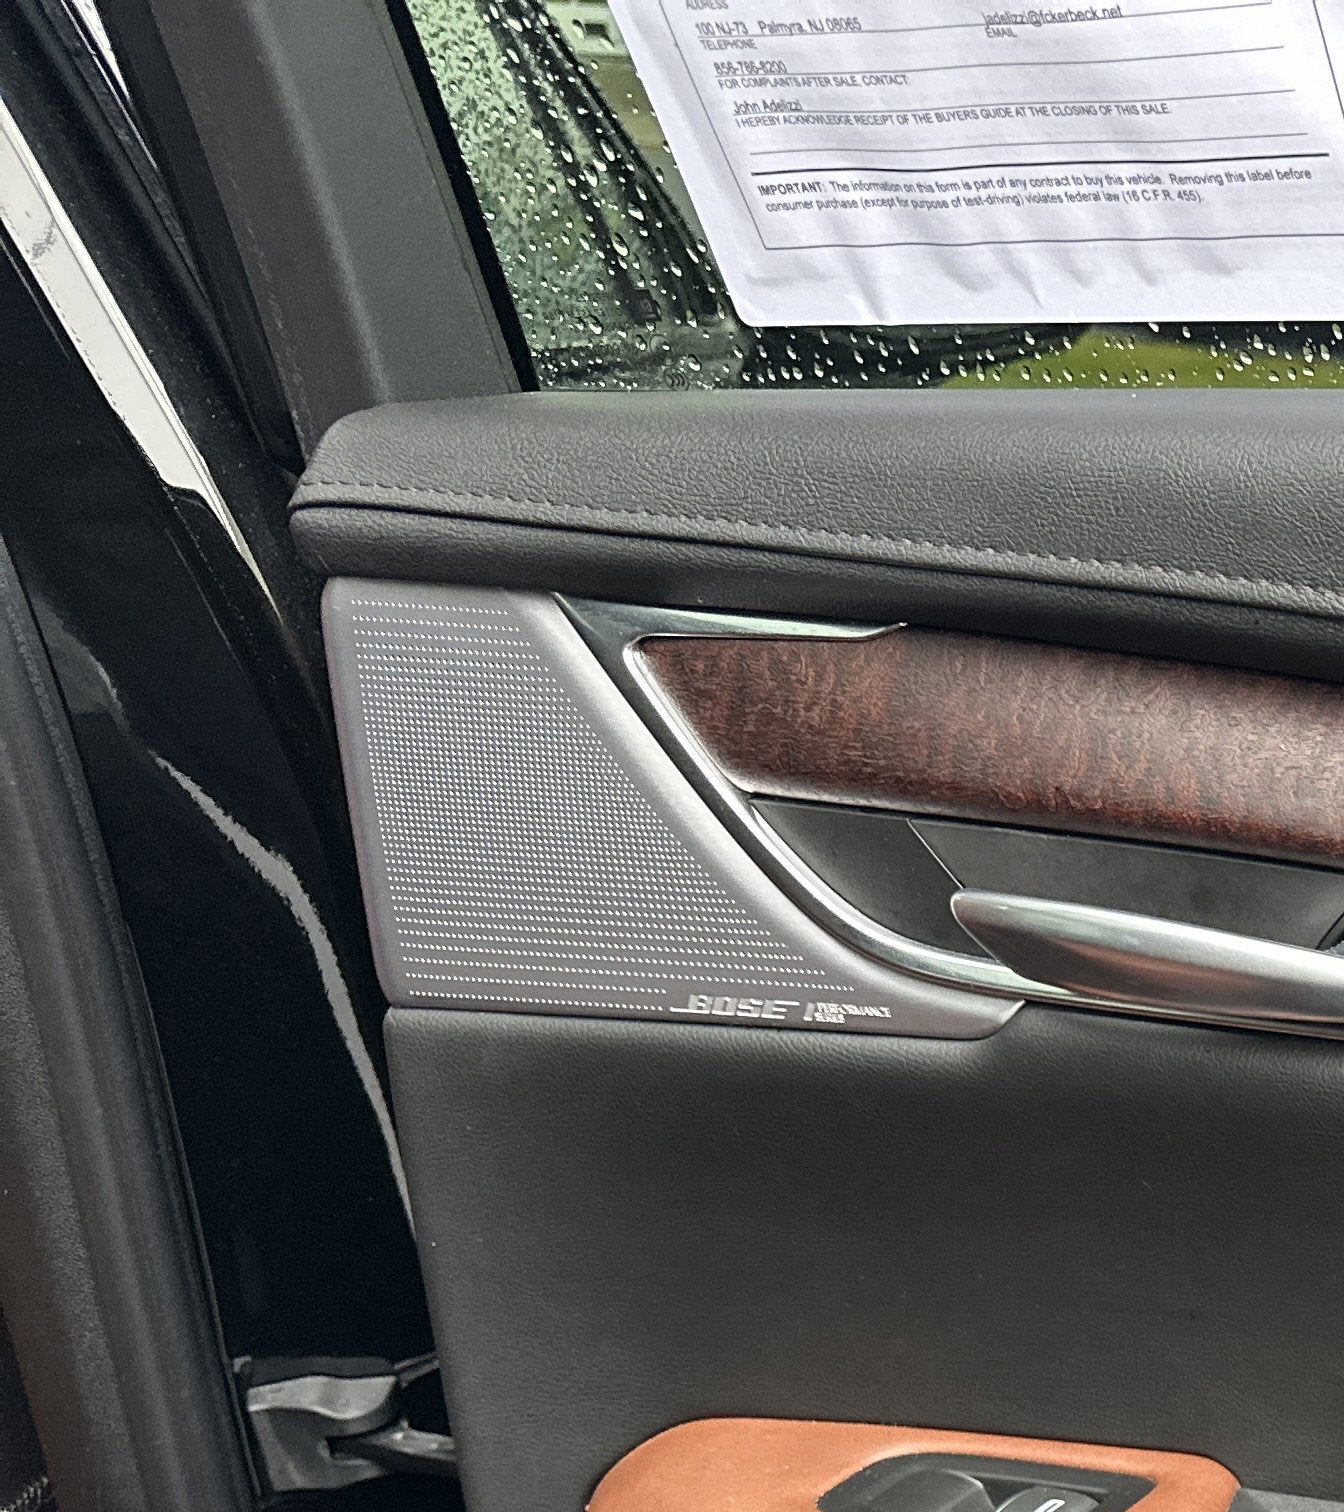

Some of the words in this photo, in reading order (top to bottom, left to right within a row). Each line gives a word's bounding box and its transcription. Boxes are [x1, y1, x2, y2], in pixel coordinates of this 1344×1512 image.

[695, 22, 715, 35] 100
[715, 21, 748, 35] NJ-73
[807, 18, 826, 33] NJ
[827, 17, 862, 32] 08065
[985, 27, 1018, 38] EMAIL
[700, 39, 757, 50] TELEPHONE
[718, 78, 740, 89] FOR
[741, 77, 800, 88] COMPLAINTS
[802, 76, 833, 87] AFTER
[734, 101, 760, 115] John
[742, 115, 780, 128] HEREBY
[783, 114, 853, 126] ACKNOWLEDGE
[855, 113, 896, 126] RECEIPT
[897, 113, 910, 125] OF
[912, 112, 933, 124] THE
[936, 109, 979, 123] BUYERS
[980, 107, 1013, 119] GUIDE
[1015, 107, 1027, 118] AT
[1028, 106, 1050, 117] THE
[1051, 105, 1098, 116] CLOSING
[1100, 105, 1113, 116] OF
[1115, 104, 1140, 115] THIS
[758, 181, 826, 197] IMPORTANT:
[828, 181, 849, 193] The
[851, 180, 902, 193] information
[903, 183, 916, 193] on
[916, 181, 935, 194] this
[935, 181, 961, 193] form
[961, 179, 973, 191] is
[973, 178, 995, 192] part
[996, 177, 1008, 189] of
[1008, 178, 1027, 190] any
[1028, 175, 1070, 188] contract
[1071, 175, 1083, 186] to
[1085, 174, 1104, 189] buy
[1104, 173, 1123, 186] this
[1169, 171, 1224, 186] Removing
[1225, 170, 1246, 182] this
[1247, 169, 1274, 181] label
[1275, 168, 1312, 181] before
[765, 199, 814, 212] consumer
[815, 197, 858, 211] purchase
[910, 199, 949, 211] purpose
[951, 196, 962, 208] of
[1024, 192, 1064, 204] violates
[1064, 191, 1101, 203] federal
[1102, 191, 1120, 202] law
[670, 994, 800, 1020] BOSE
